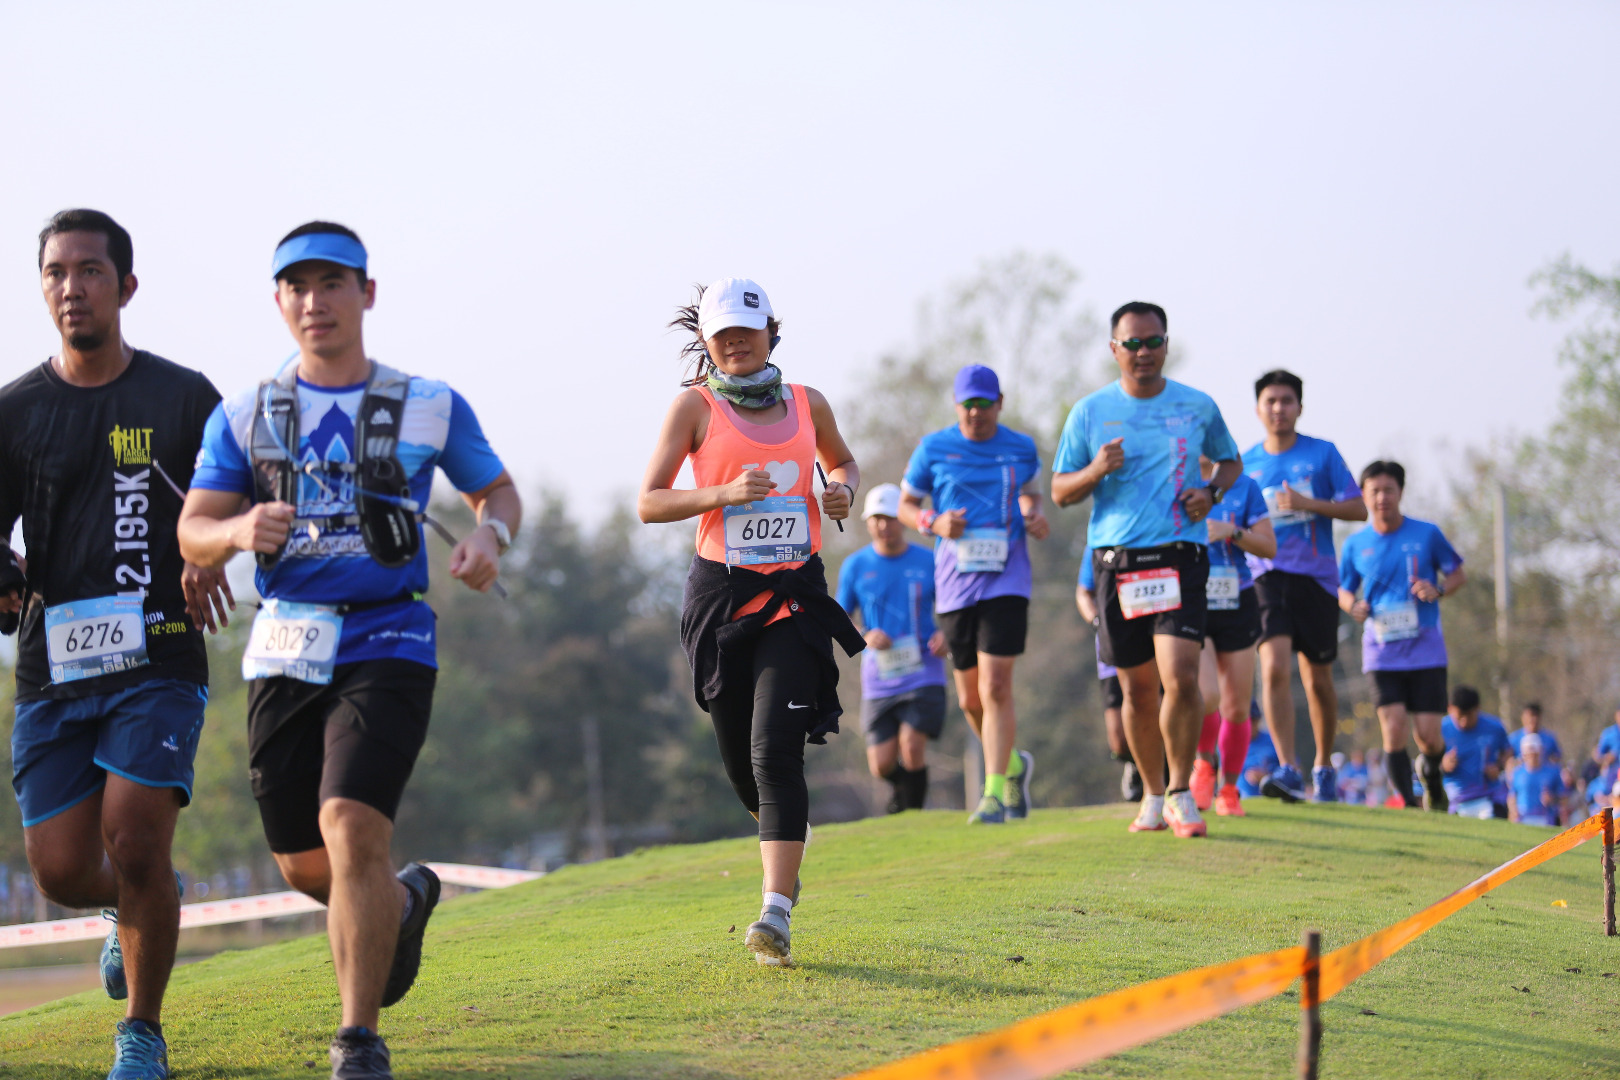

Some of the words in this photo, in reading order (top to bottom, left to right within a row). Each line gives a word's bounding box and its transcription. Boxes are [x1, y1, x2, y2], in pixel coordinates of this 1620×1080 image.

[123, 428, 153, 449] HIT
[742, 517, 796, 540] 6027
[66, 620, 123, 652] 6276
[265, 626, 319, 652] 6029
